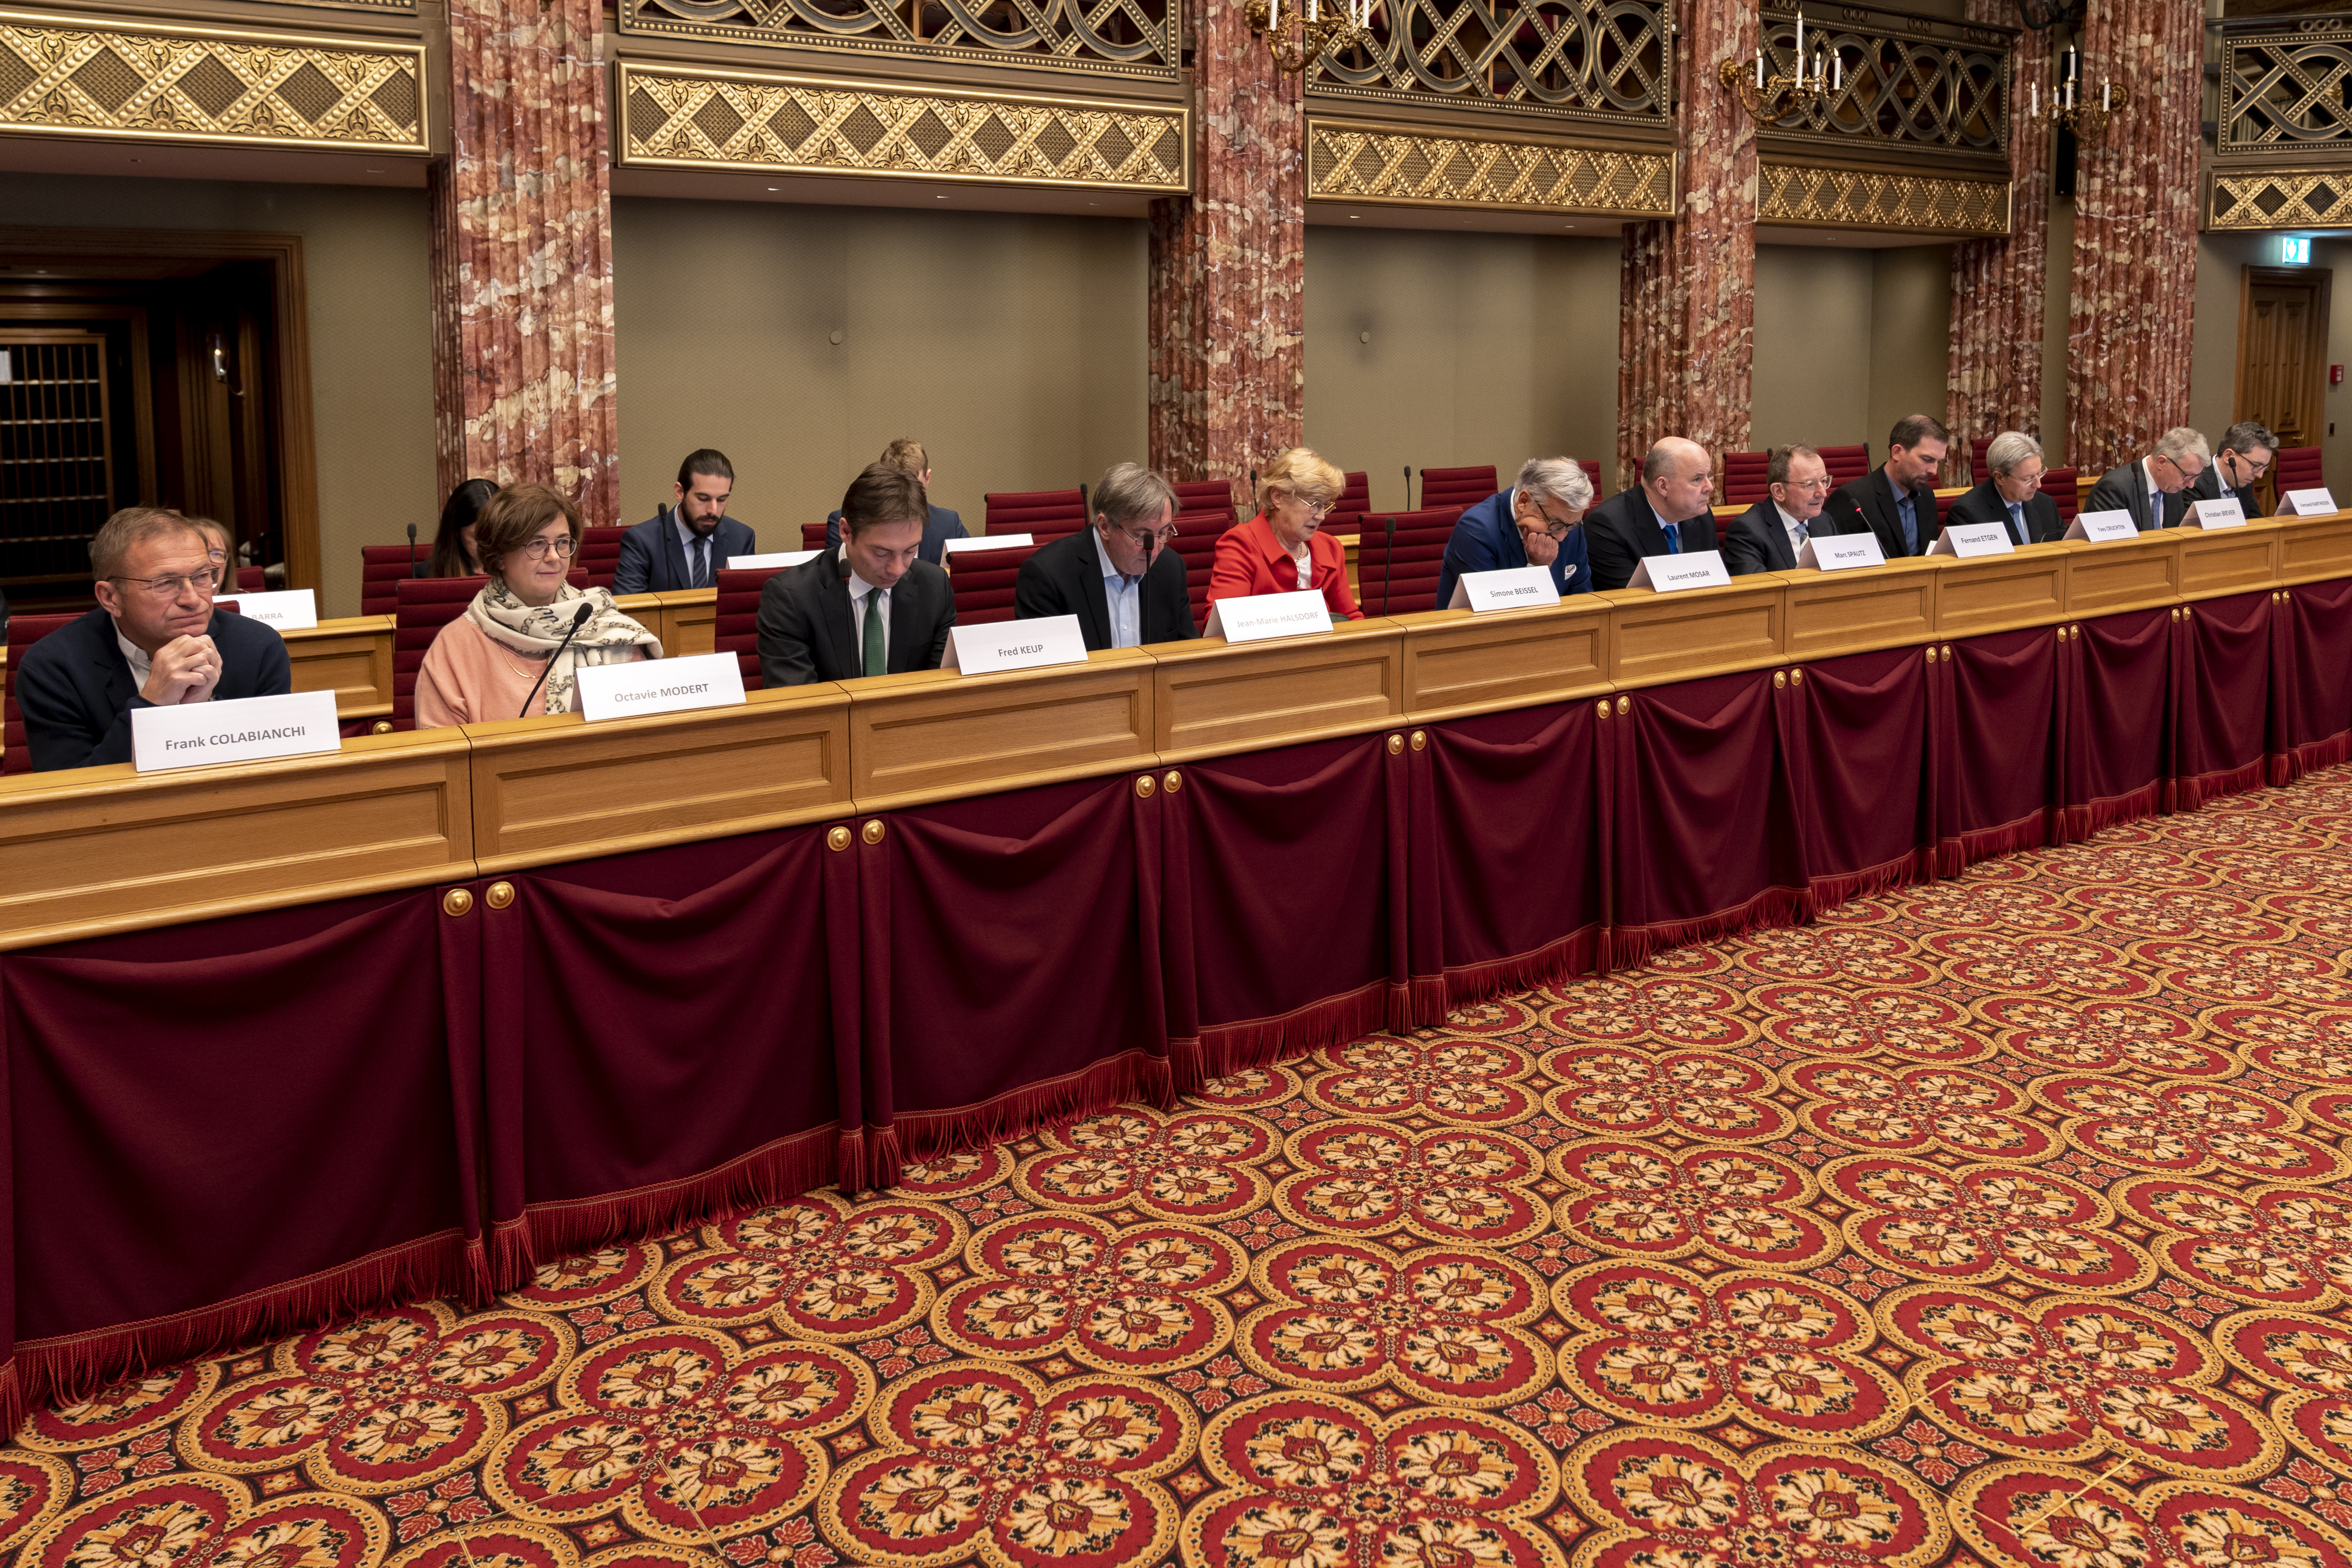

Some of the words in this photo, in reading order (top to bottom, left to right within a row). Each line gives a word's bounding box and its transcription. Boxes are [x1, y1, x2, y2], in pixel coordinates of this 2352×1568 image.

[1514, 587, 1538, 595] BEISSEL
[1237, 617, 1279, 627] Jean-Marie
[1280, 612, 1318, 622] HALSDORF
[998, 647, 1018, 657] Fred
[1020, 644, 1043, 654] KEUP
[615, 690, 657, 702] Octavie
[660, 684, 709, 698] MODERT
[165, 736, 206, 750] Frank
[209, 726, 306, 745] COLABIANCHI
